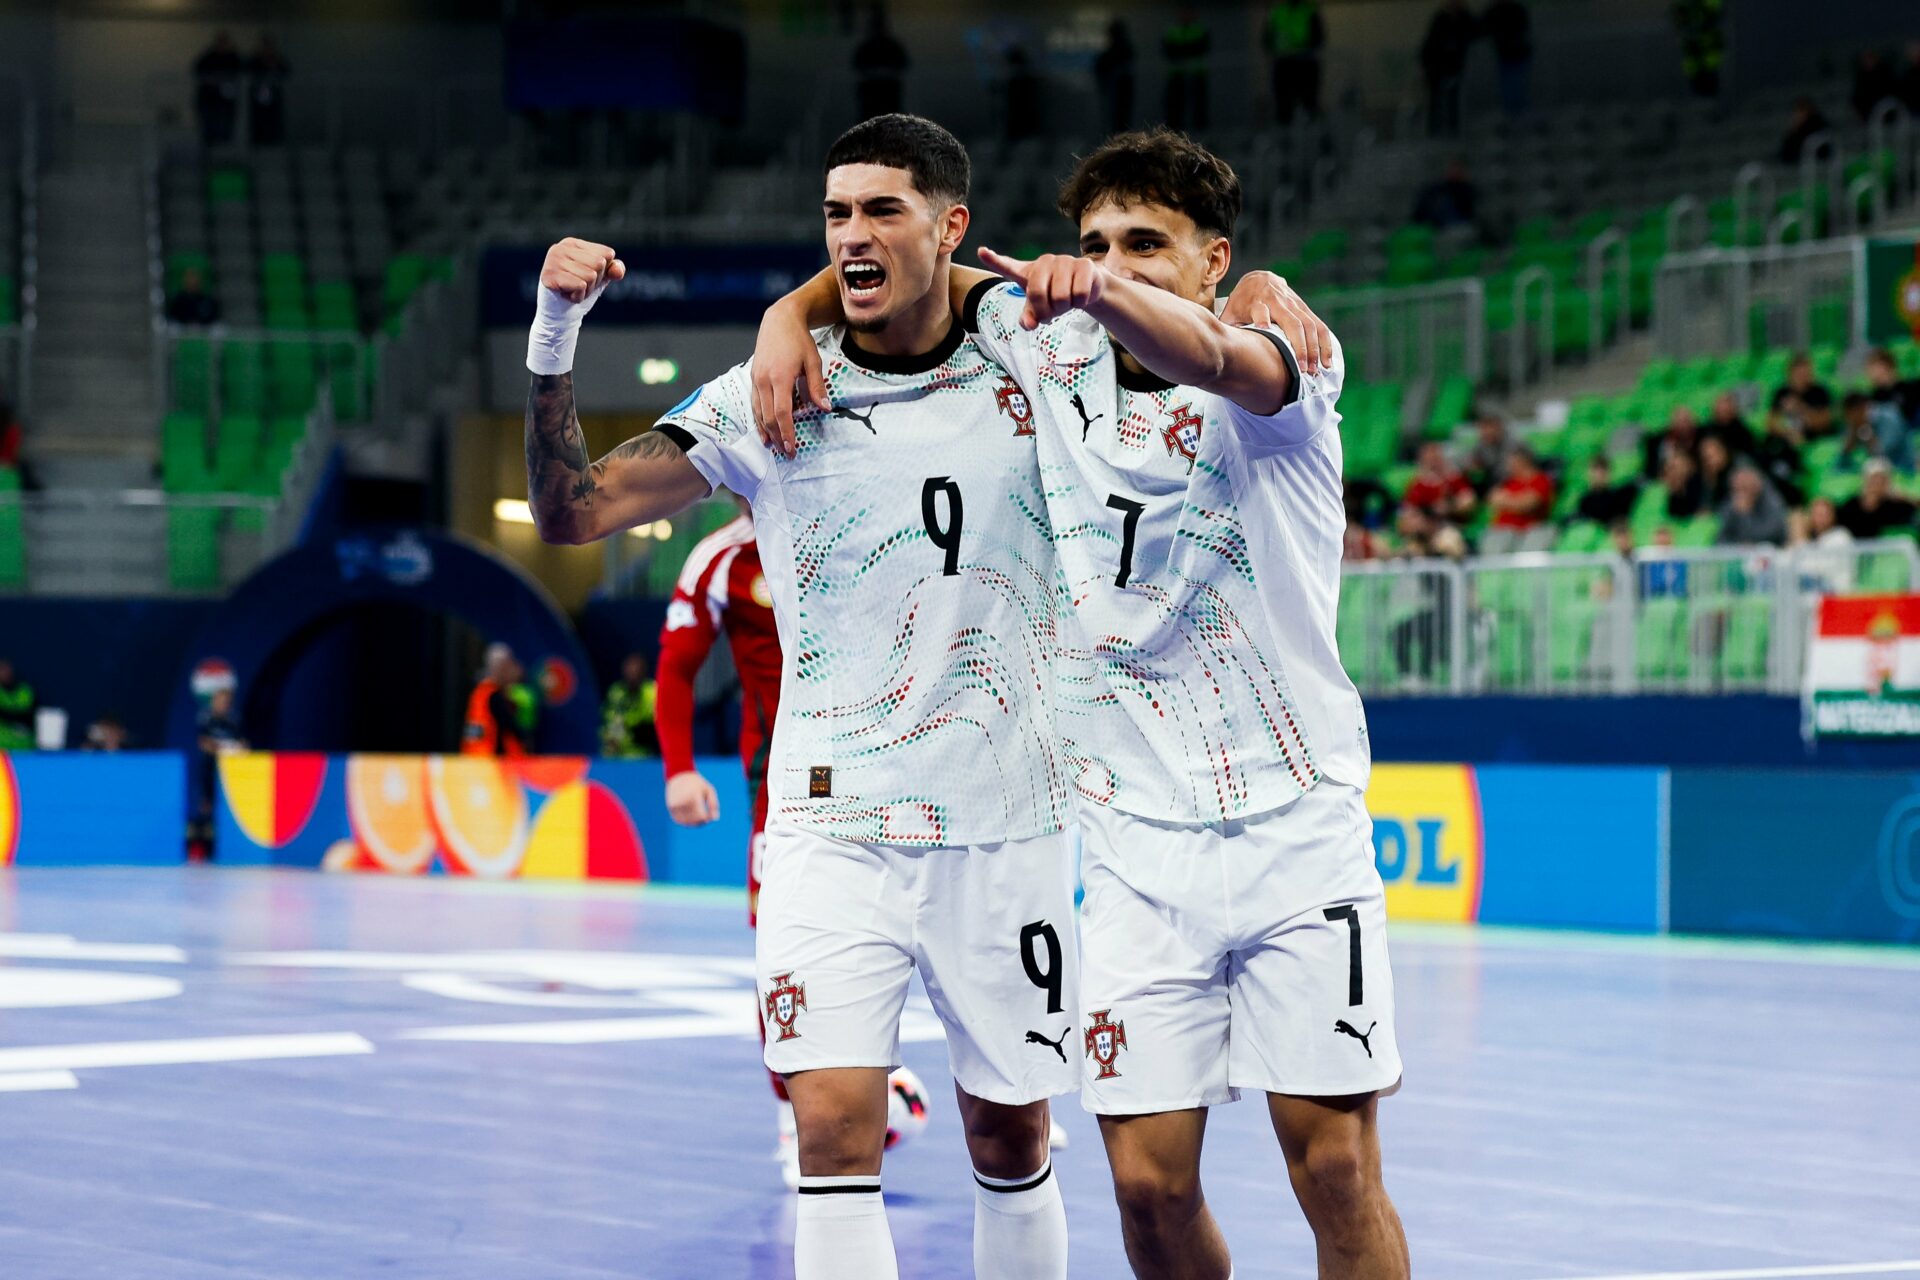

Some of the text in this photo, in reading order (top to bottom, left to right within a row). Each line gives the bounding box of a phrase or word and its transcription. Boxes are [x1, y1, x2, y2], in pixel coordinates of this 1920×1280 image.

[921, 476, 963, 576] 9
[1106, 493, 1148, 589] 7
[1372, 818, 1458, 883] DL
[1020, 920, 1065, 1014] 9
[1323, 904, 1363, 1007] 7
